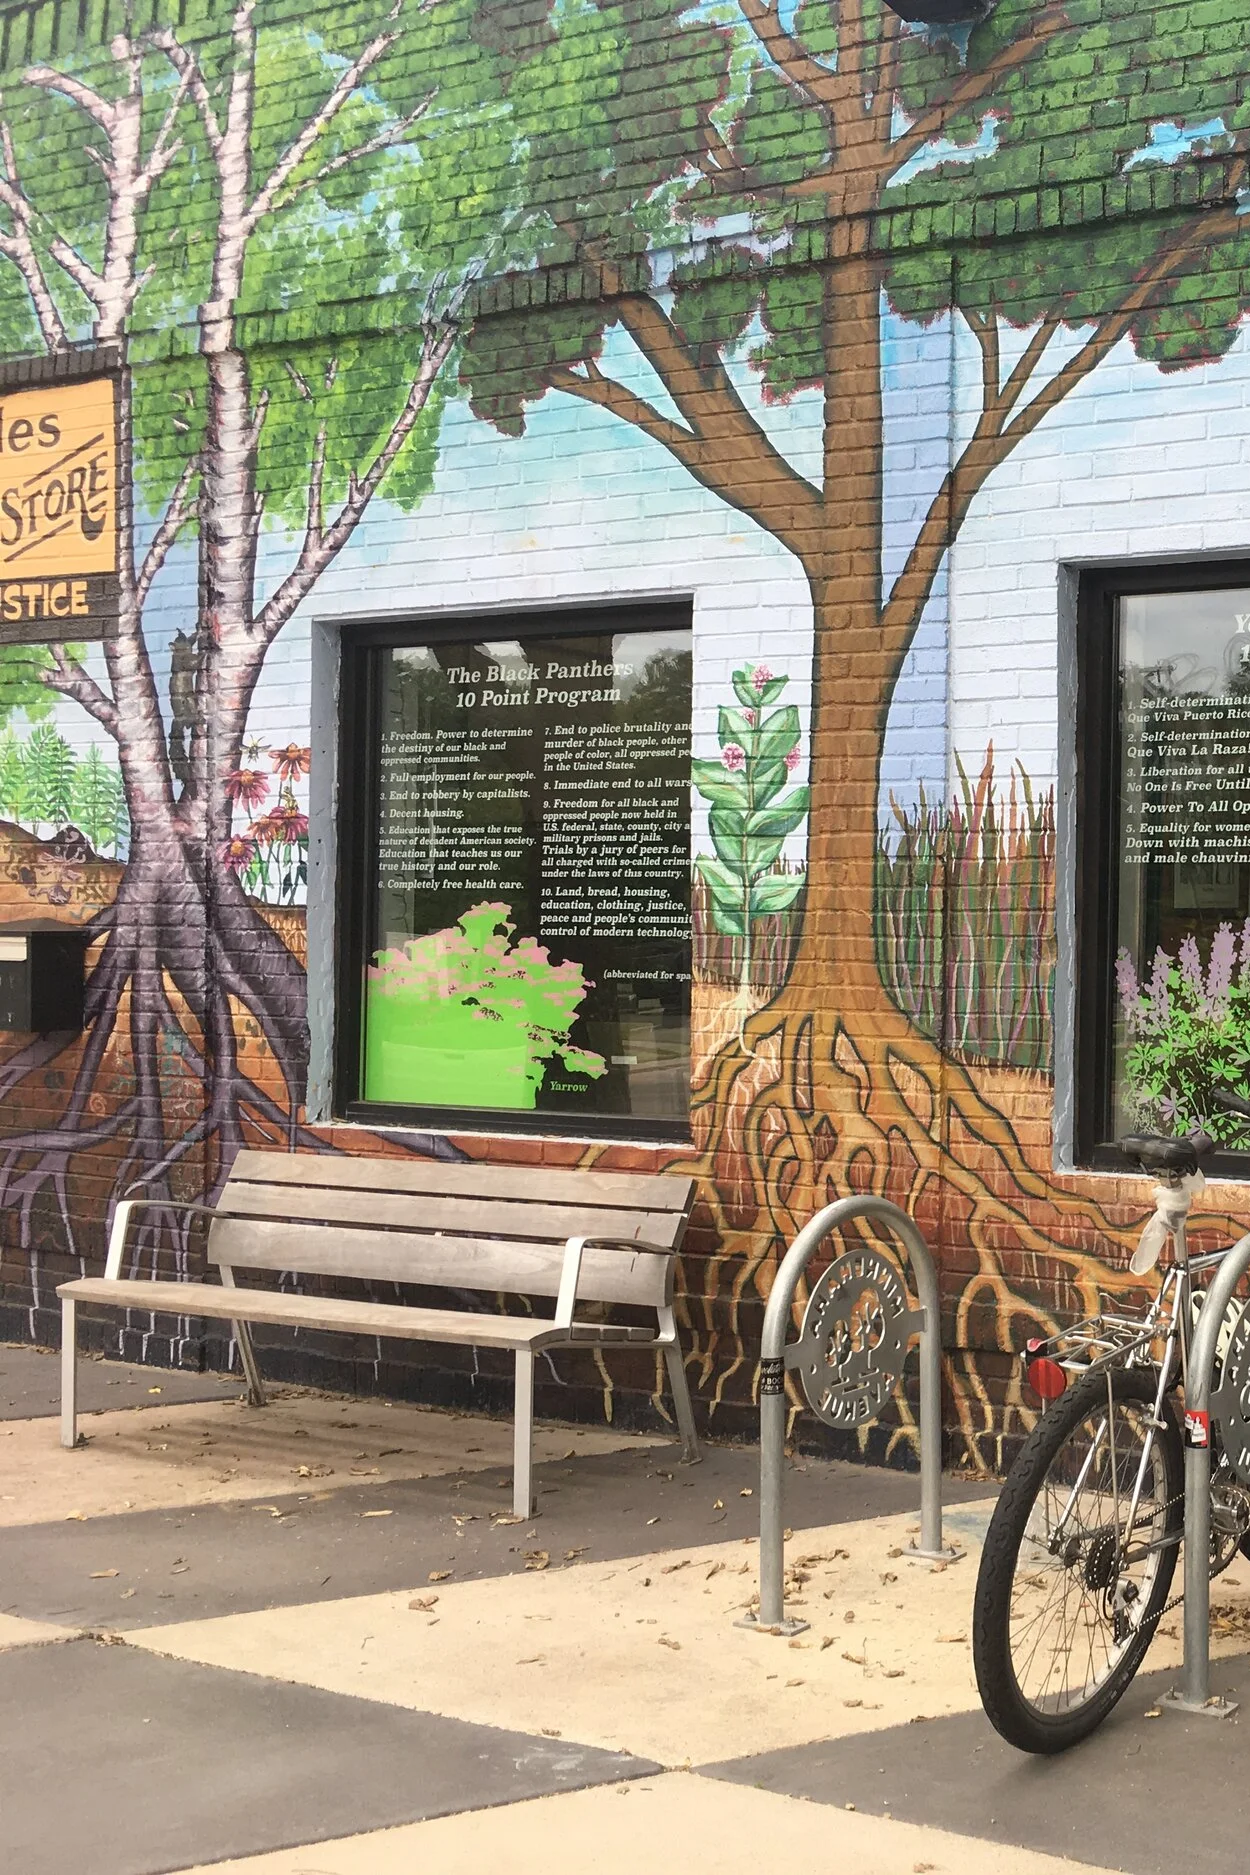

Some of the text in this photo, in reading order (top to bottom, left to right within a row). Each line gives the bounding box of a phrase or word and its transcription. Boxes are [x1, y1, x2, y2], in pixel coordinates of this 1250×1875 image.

[1, 450, 109, 546] STORE
[0, 582, 89, 620] STICE
[447, 659, 634, 685] The Black Panthers
[456, 687, 622, 708] 10 Point Program
[389, 729, 433, 740] Freedom.
[435, 728, 467, 742] Power
[468, 729, 479, 738] to
[480, 726, 533, 738] determine
[1126, 746, 1153, 758] Que
[1156, 744, 1187, 756] Viva
[1189, 743, 1208, 756] La
[1126, 782, 1142, 791] No
[1144, 781, 1168, 792] One
[1170, 780, 1182, 791] Is
[1184, 780, 1212, 790] Free
[1215, 776, 1250, 790] Until
[388, 789, 408, 800] End
[410, 791, 420, 800] to
[421, 788, 461, 801] robbery
[461, 788, 475, 801] by
[475, 787, 531, 800] capitalists.
[552, 797, 598, 808] Freedom
[600, 797, 616, 808] for
[616, 797, 630, 807] all
[631, 797, 659, 807] black
[659, 796, 680, 807] and
[1126, 804, 1135, 813] 4.
[1140, 801, 1184, 813] Power
[1186, 800, 1204, 812] To
[1206, 799, 1229, 812] All
[1125, 823, 1135, 833] 5.
[1138, 821, 1190, 835] Equality
[1192, 821, 1212, 832] for
[1125, 836, 1163, 848] Down
[1167, 835, 1200, 848] with
[386, 878, 441, 891] Completely
[441, 878, 463, 889] free
[463, 878, 497, 889] health
[498, 880, 524, 889] care.
[554, 885, 585, 898] Land,
[586, 885, 621, 897] bread,
[622, 885, 670, 899] housing,
[540, 898, 686, 912] education, clothing, justice,
[549, 1080, 588, 1092] Yarrow
